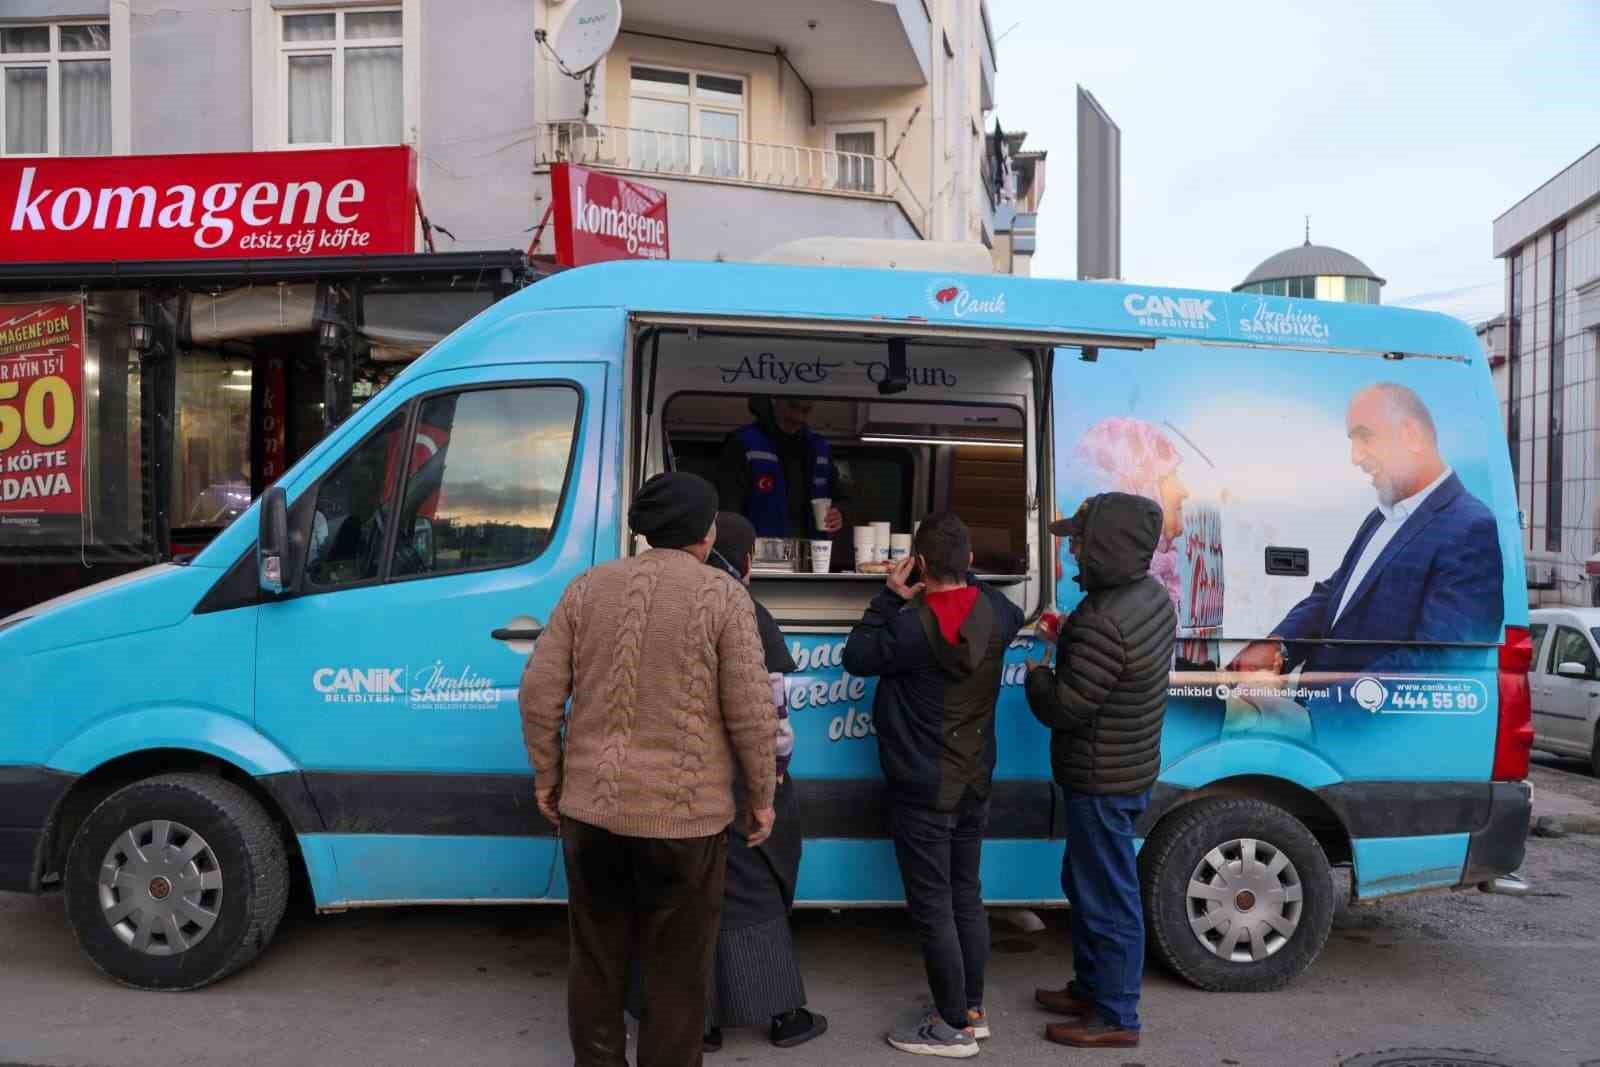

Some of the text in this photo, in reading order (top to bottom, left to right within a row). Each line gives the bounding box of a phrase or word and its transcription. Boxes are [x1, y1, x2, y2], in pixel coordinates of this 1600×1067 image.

[10, 167, 365, 248] komagene
[576, 185, 665, 254] komagene
[240, 227, 371, 254] etsiz çiğ köfte
[954, 289, 1006, 317] Canik
[719, 352, 843, 385] Afiyet
[7, 449, 68, 473] KÖFTE
[0, 472, 73, 502] DAVA
[1391, 691, 1478, 709] 444 55 90
[828, 706, 879, 741] ols
